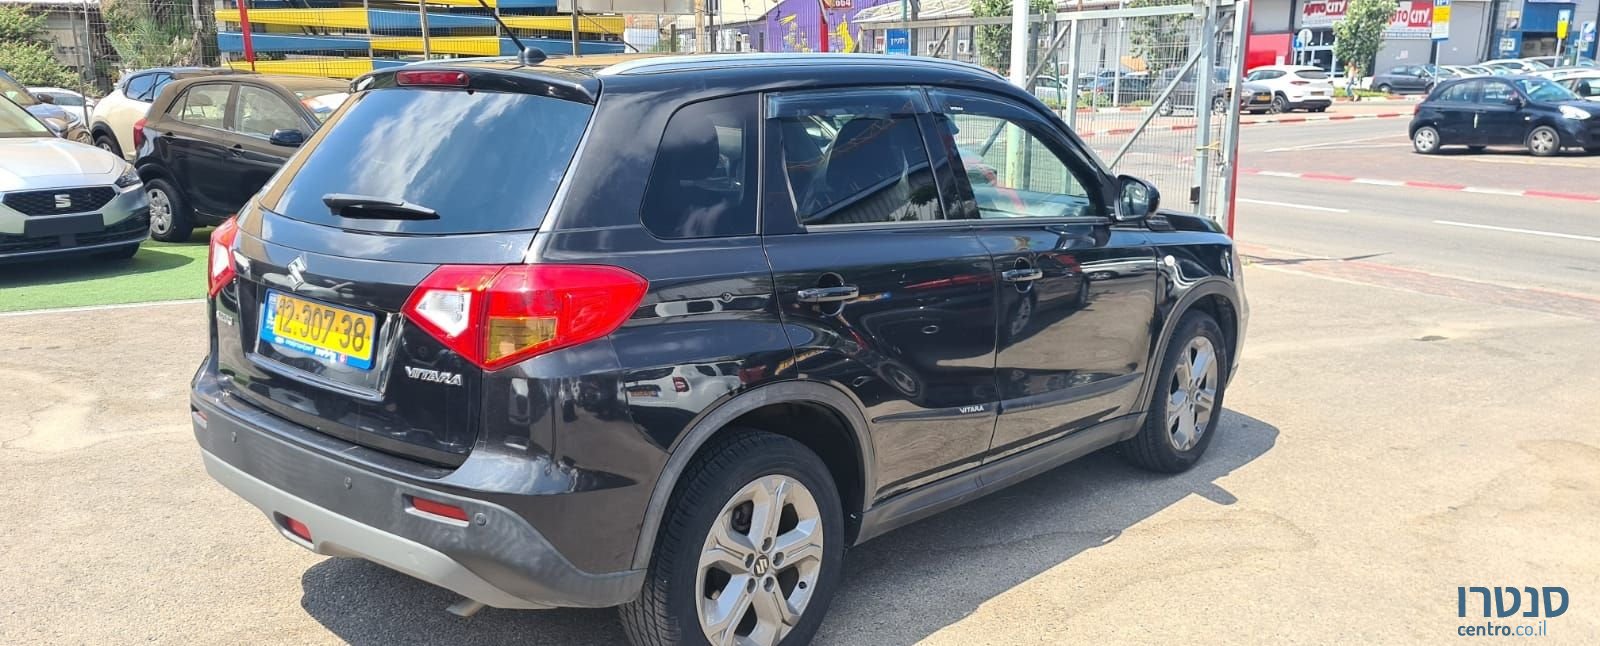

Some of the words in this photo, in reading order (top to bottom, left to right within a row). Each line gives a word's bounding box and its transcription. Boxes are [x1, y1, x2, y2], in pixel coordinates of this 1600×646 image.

[1326, 1, 1345, 13] CITY
[1410, 8, 1430, 23] CITY
[404, 365, 463, 386] VITARA
[959, 405, 984, 413] VITARA
